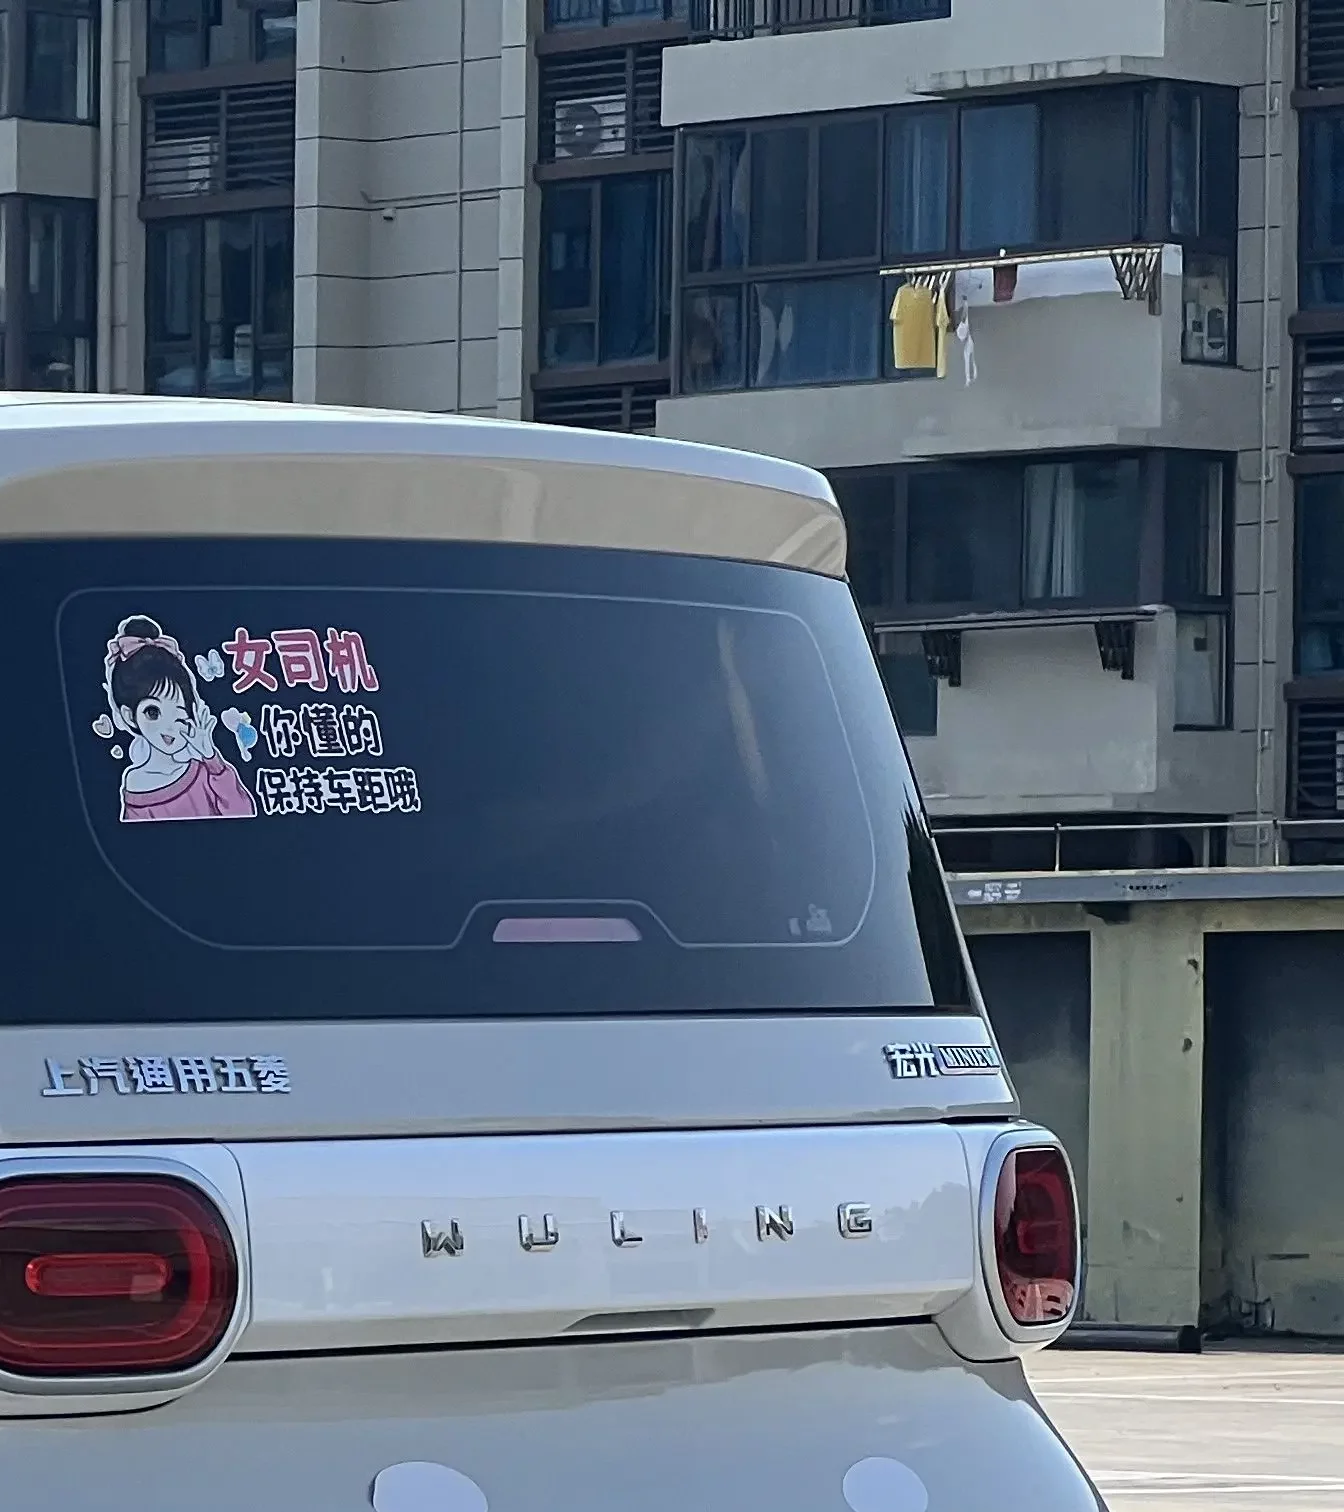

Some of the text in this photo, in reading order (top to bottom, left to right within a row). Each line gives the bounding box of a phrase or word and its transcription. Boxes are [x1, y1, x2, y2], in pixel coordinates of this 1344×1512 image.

[224, 628, 379, 693] 女司机
[260, 704, 383, 758] 你懂的
[256, 767, 422, 814] 保持车距哦
[41, 1055, 292, 1096] 上汽通用五菱
[421, 1201, 873, 1258] WULING
